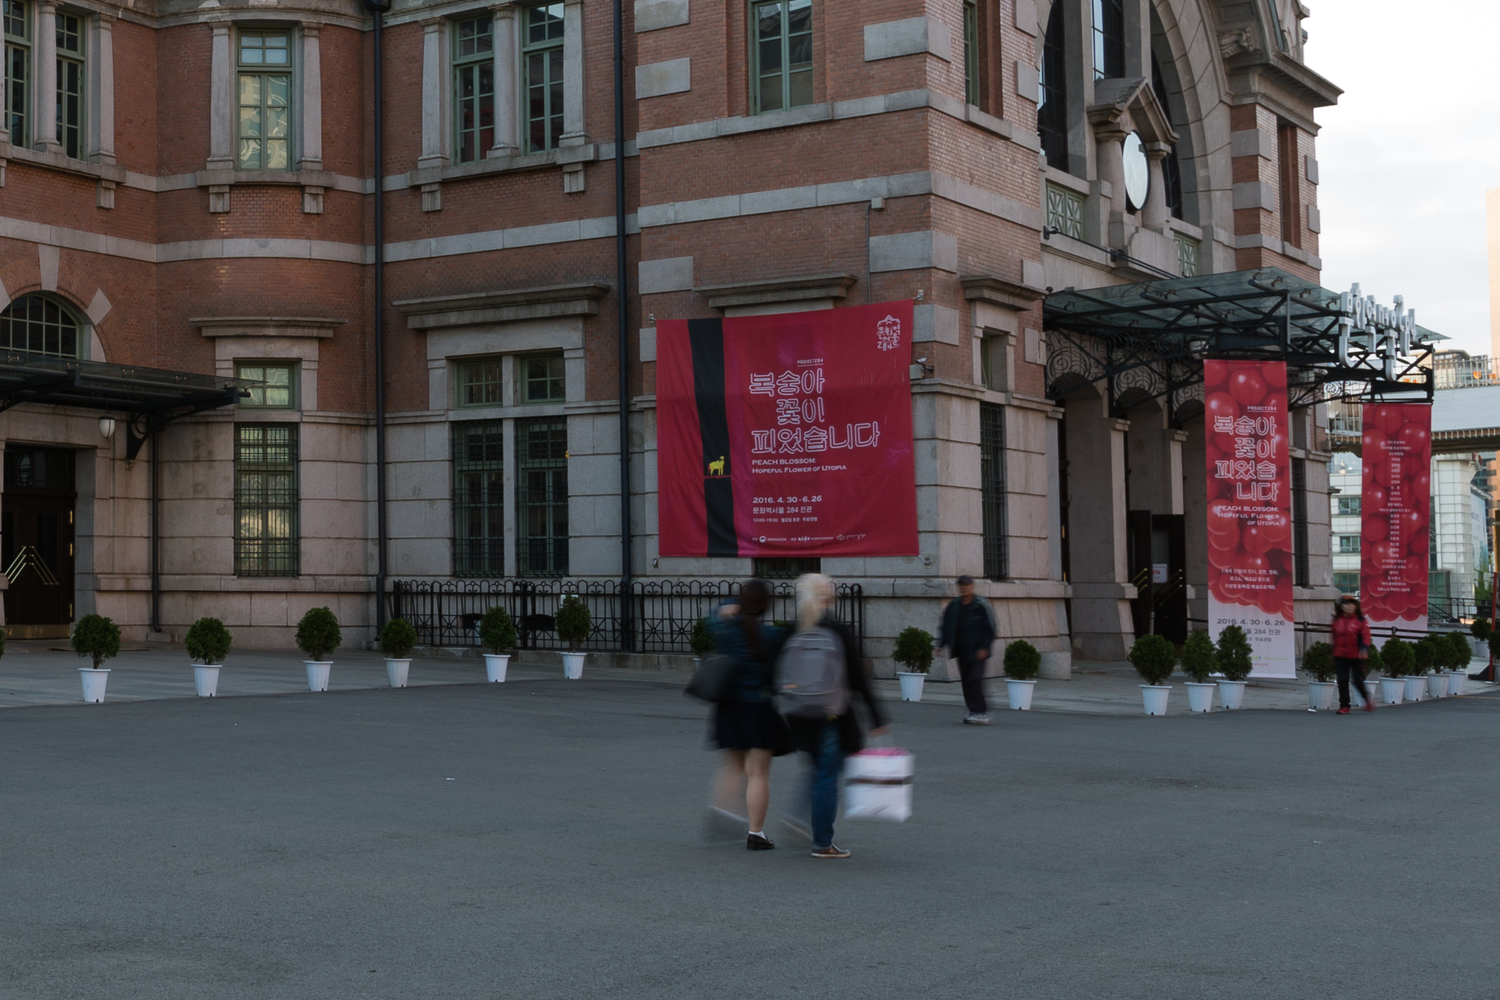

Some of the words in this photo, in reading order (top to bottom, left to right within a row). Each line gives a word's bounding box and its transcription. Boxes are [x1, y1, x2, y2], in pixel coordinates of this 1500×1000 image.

[749, 368, 825, 397] 복숭아
[776, 397, 825, 425] 꽃이
[1213, 415, 1277, 436] 복숭아
[751, 421, 880, 454] 피었습니다
[1234, 438, 1276, 458] 꽃이
[1215, 460, 1276, 480] 피었습
[1236, 482, 1278, 501] 니다
